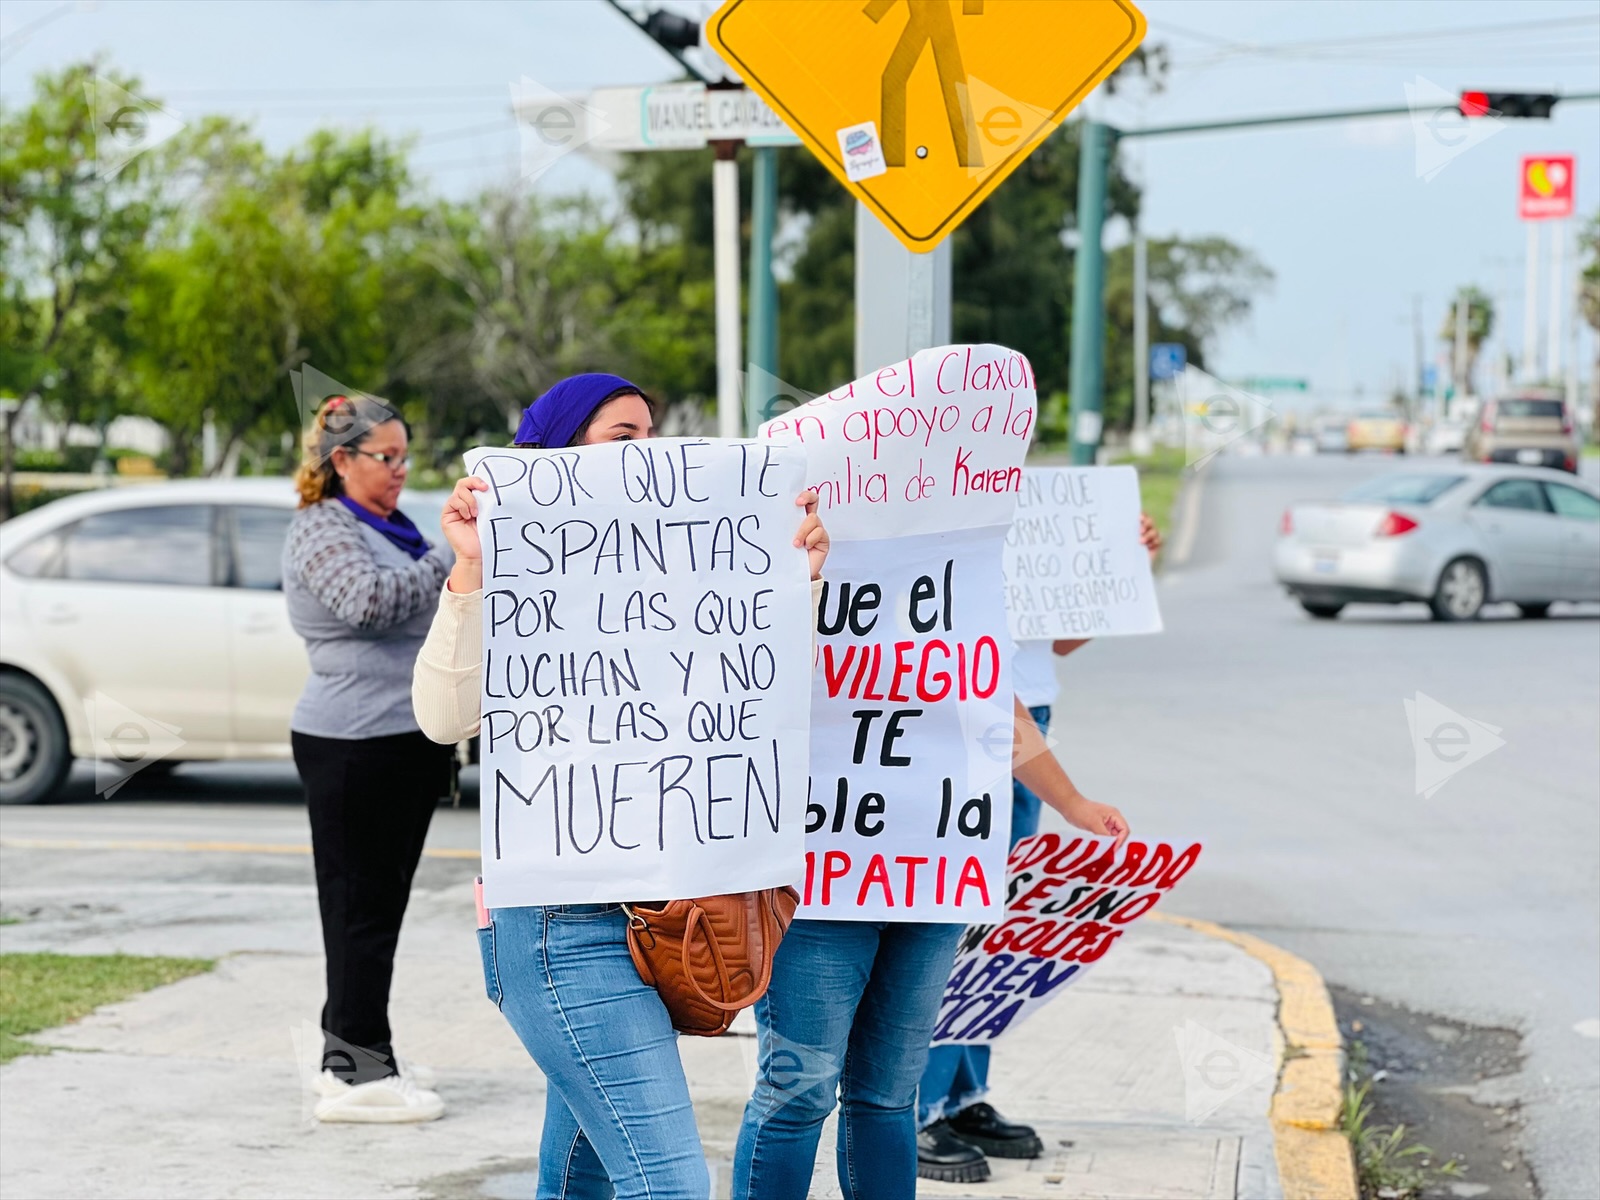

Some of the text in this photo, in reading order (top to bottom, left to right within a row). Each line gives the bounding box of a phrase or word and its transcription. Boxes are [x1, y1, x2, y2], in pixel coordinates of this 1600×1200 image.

[649, 102, 714, 131] MANUEL
[876, 358, 915, 398] el
[767, 392, 1033, 460] en apoyo a la
[472, 453, 594, 507] POR
[728, 442, 789, 497] TE
[904, 458, 935, 502] de
[952, 446, 1021, 496] Karen
[1050, 471, 1093, 508] QUE
[489, 514, 772, 579] ESPANTAS
[1072, 513, 1102, 543] DE
[1072, 548, 1114, 579] QUE
[484, 589, 774, 638] POR LAS QUE
[909, 559, 954, 634] el
[1016, 613, 1050, 638] QUE
[485, 643, 776, 699] LUCHAN Y NO
[815, 635, 1000, 703] VILEGIO
[482, 698, 763, 754] POR LAS QUE
[852, 709, 924, 767] TE
[495, 739, 780, 860] MUEREN
[936, 776, 992, 841] la
[983, 916, 1124, 964] GOLPES
[946, 953, 1081, 999] AREN
